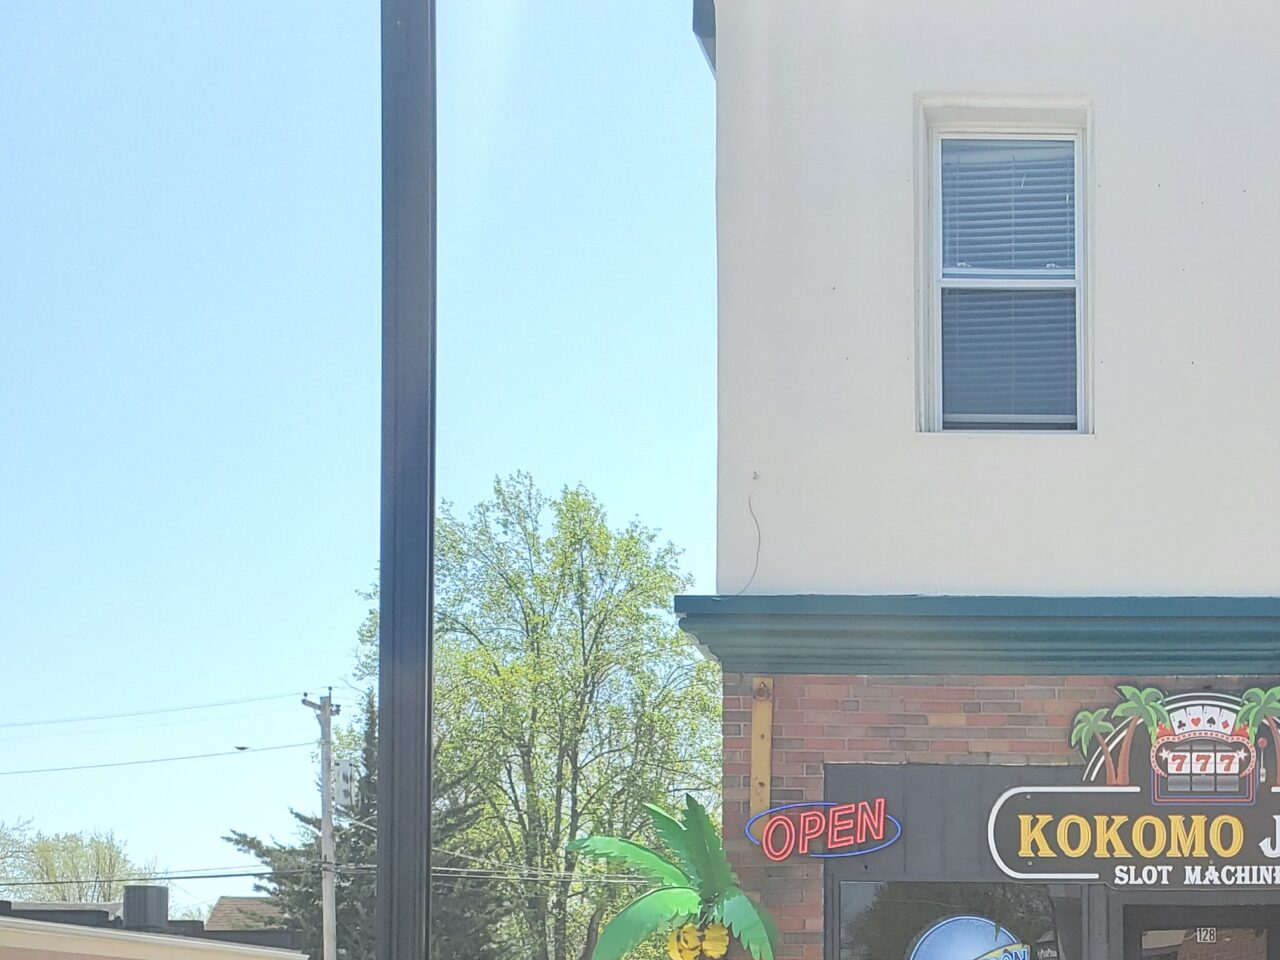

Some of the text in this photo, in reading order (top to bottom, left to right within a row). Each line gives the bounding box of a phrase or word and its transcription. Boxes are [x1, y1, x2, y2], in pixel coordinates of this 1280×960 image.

[761, 798, 887, 861] OPEN
[1017, 814, 1245, 859] KOKOMO
[1114, 865, 1171, 885] SLOT
[1198, 928, 1216, 942] 128
